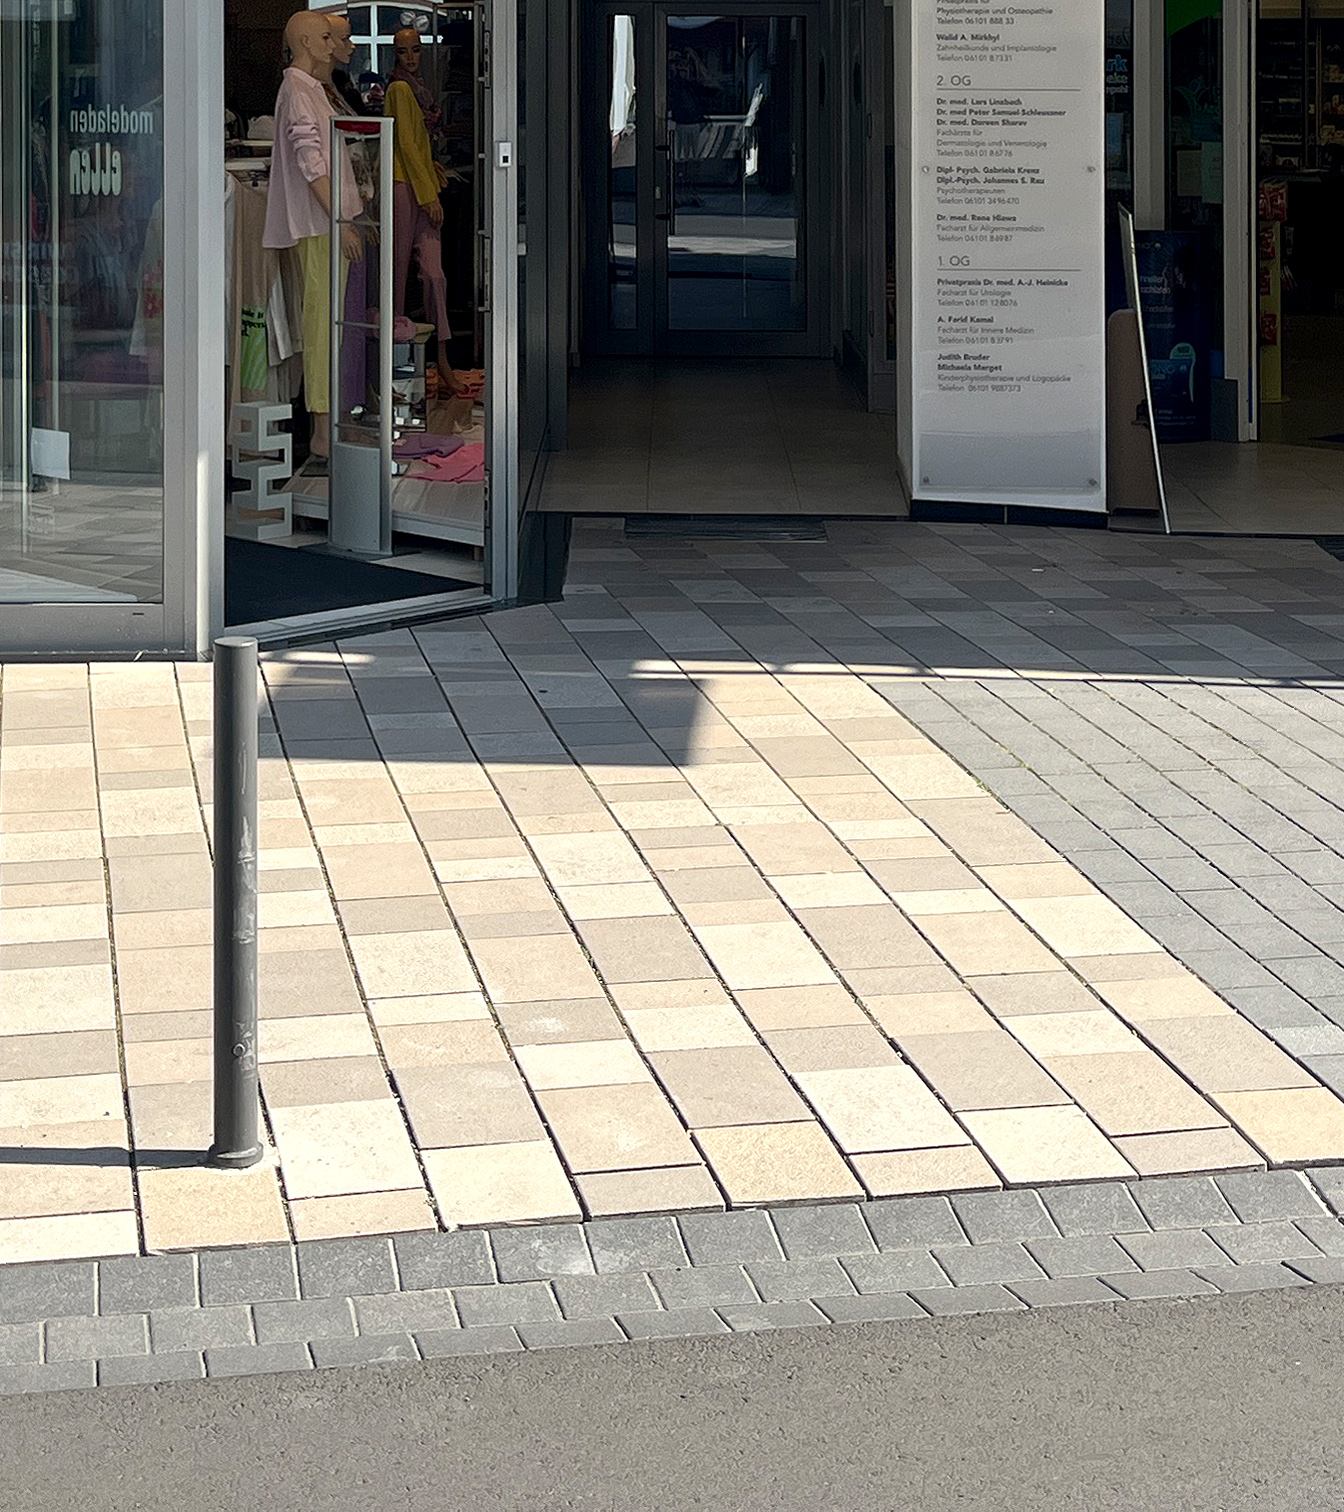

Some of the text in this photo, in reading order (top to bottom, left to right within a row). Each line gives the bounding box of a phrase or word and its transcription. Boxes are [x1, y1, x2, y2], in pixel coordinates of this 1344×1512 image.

[1008, 7, 1053, 15] Osteopathie
[1106, 54, 1128, 72] rk
[951, 76, 972, 86] OG
[950, 98, 969, 106] med.
[950, 256, 970, 266] OG
